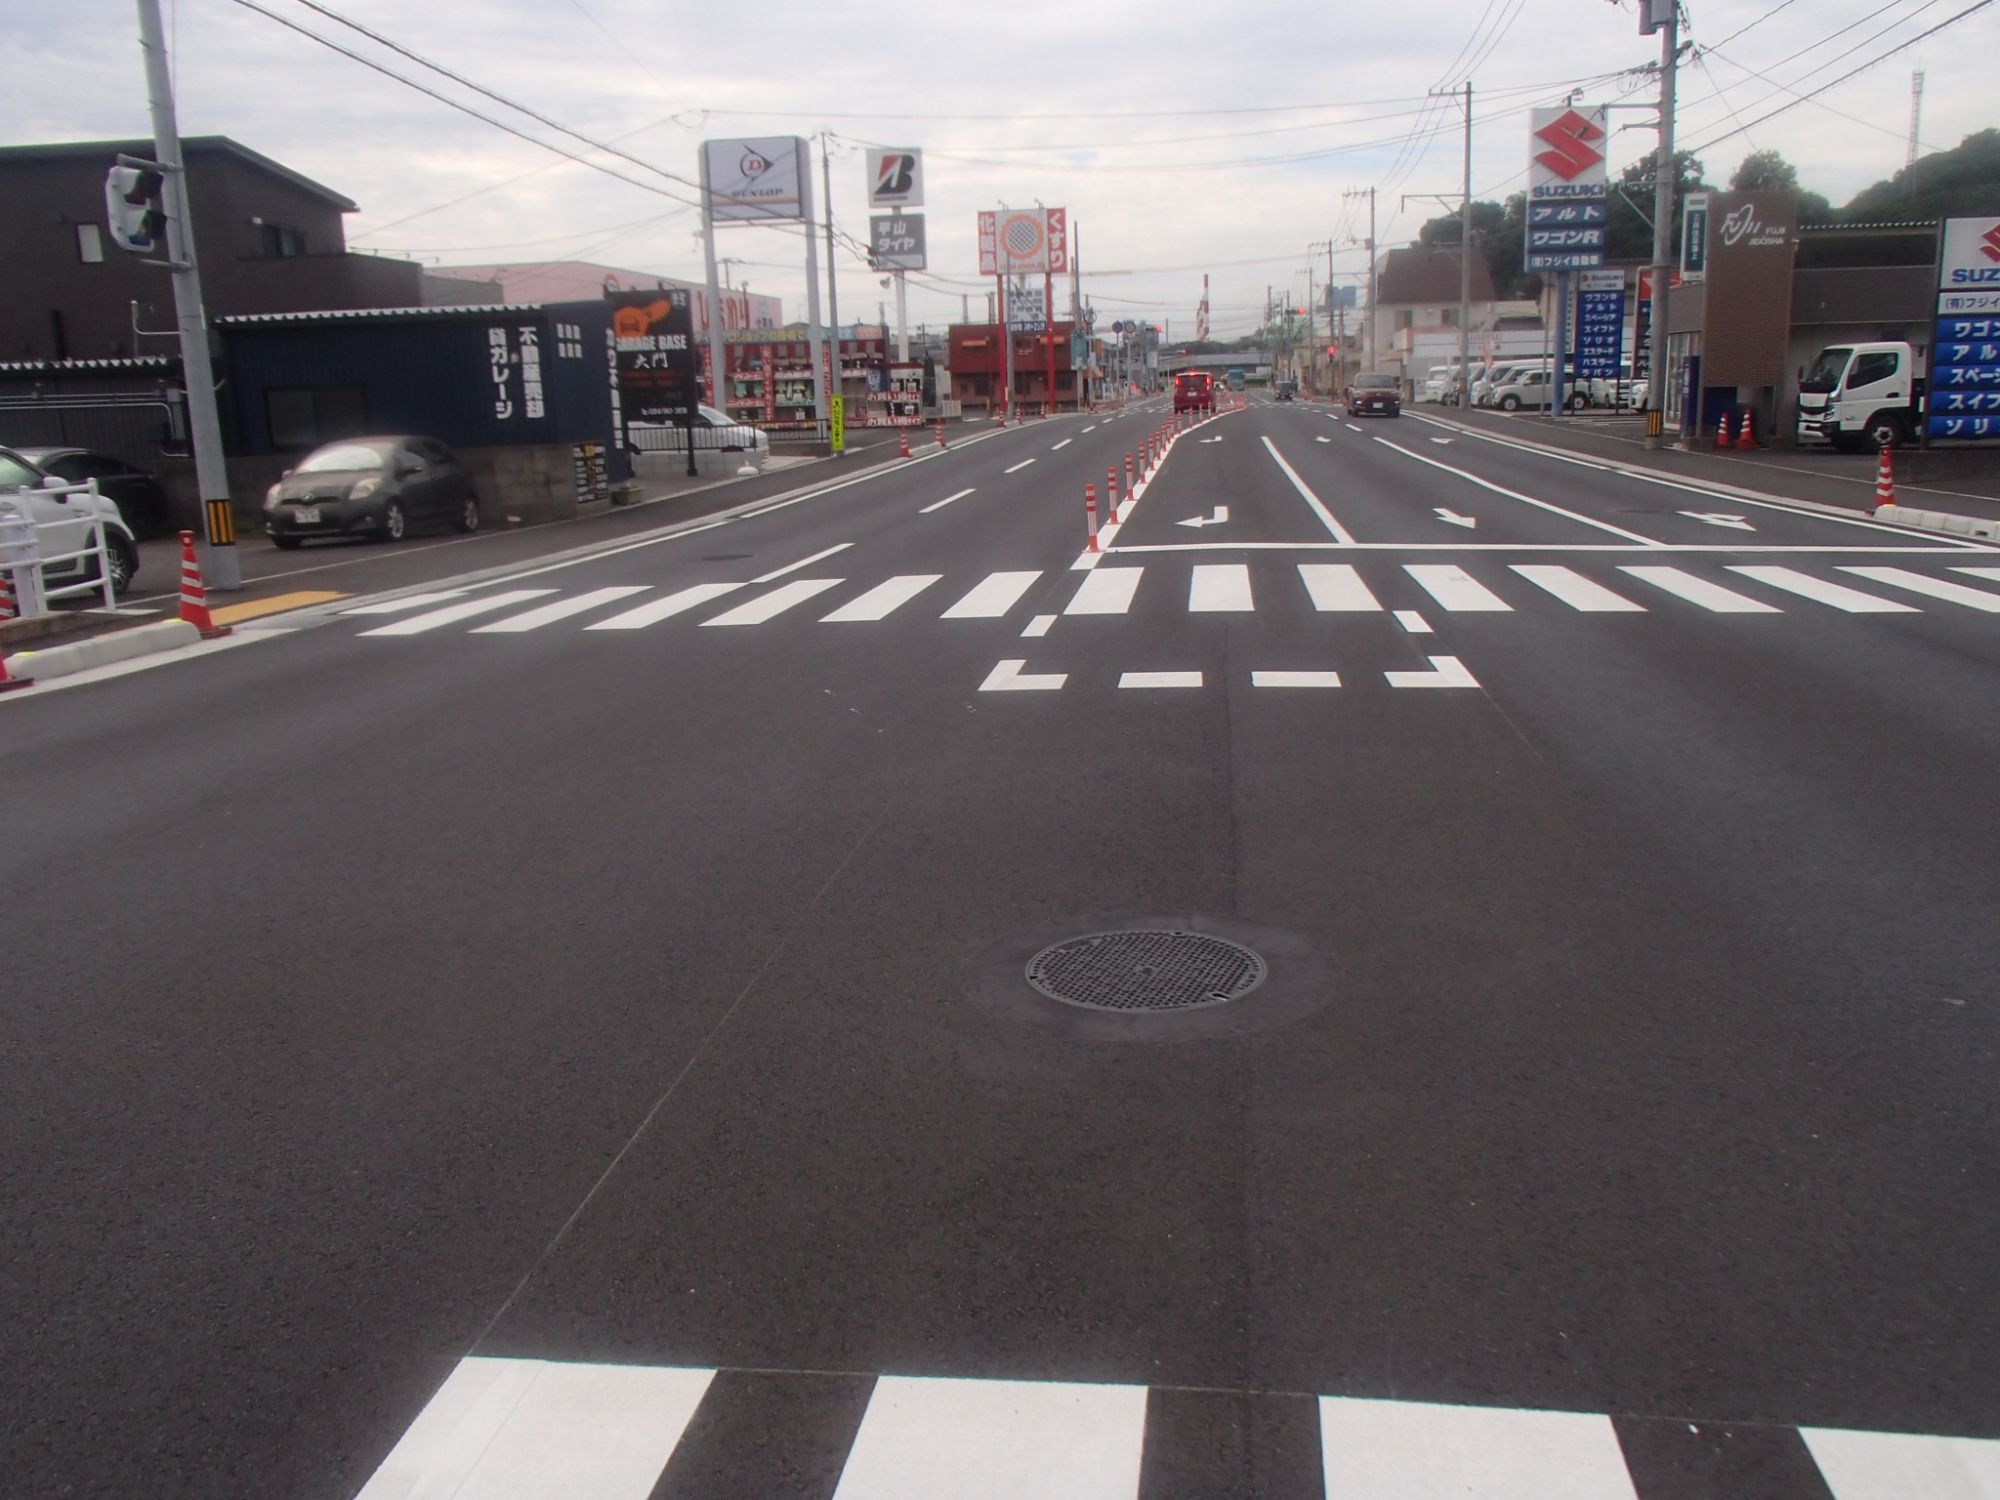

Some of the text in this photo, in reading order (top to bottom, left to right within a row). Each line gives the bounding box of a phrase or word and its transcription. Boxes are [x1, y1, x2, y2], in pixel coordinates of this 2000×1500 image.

[731, 188, 783, 198] DUNLOP
[1532, 184, 1605, 198] SUZUKI
[1533, 206, 1600, 221] アルト
[877, 236, 916, 252] タイヤ
[1048, 211, 1065, 269] くすり
[1532, 230, 1600, 246] ワゴンR
[1952, 268, 2000, 283] SUZ
[658, 334, 687, 350] BASE
[1952, 344, 1998, 361] アル
